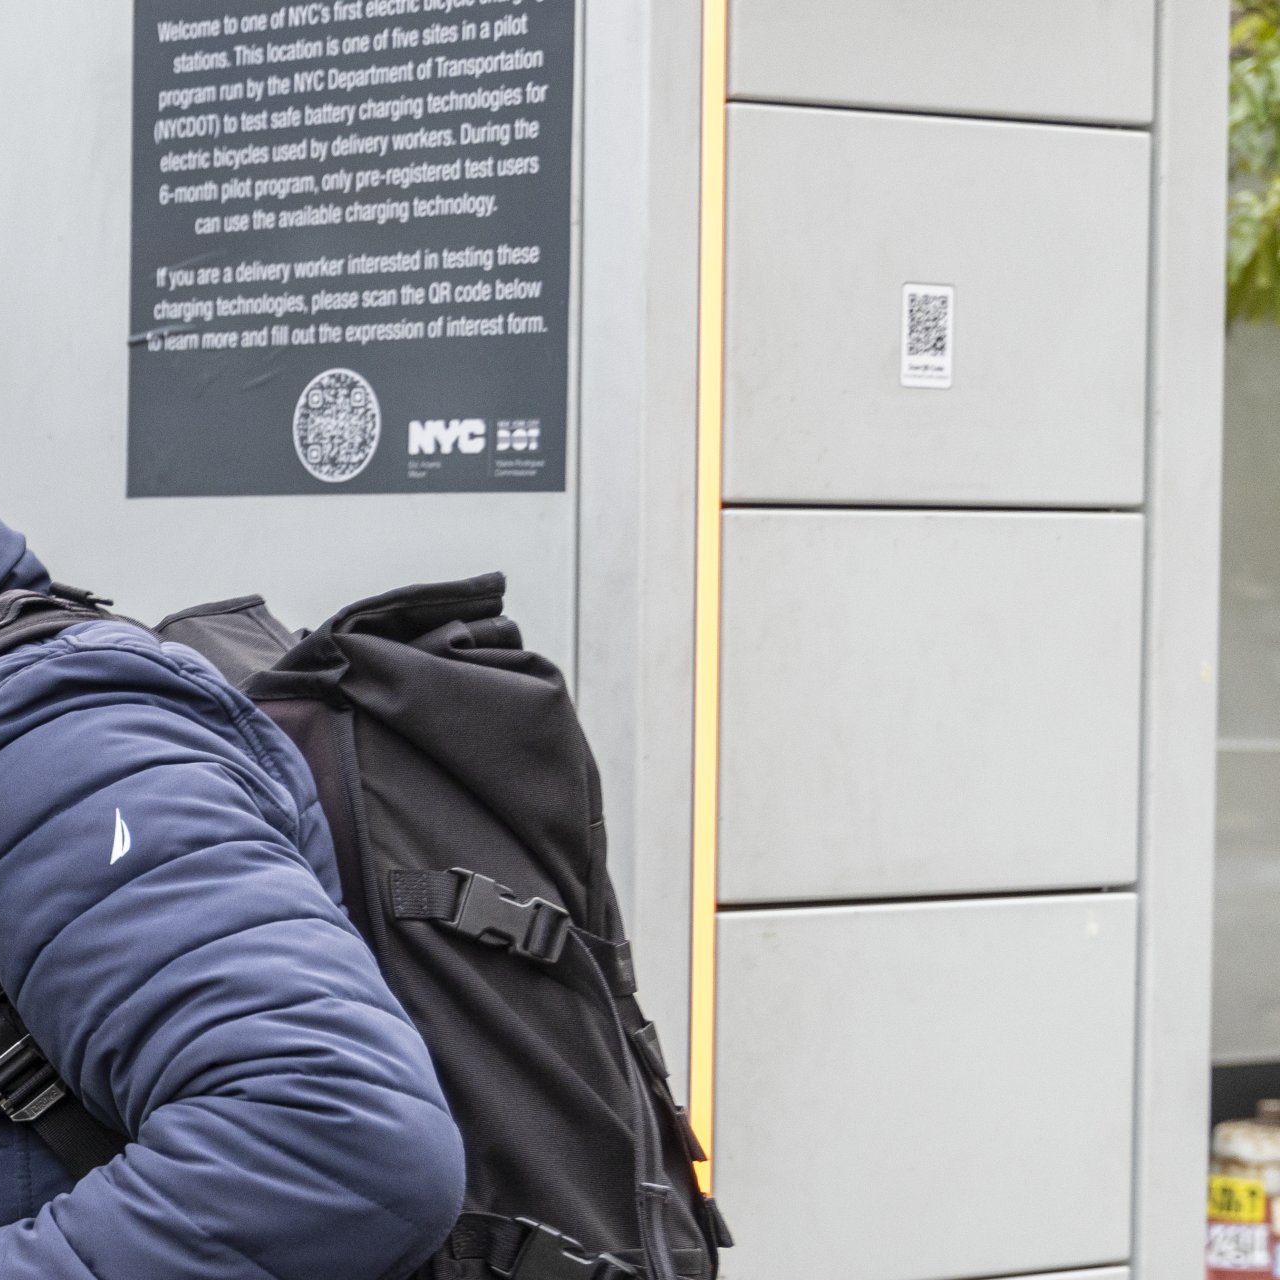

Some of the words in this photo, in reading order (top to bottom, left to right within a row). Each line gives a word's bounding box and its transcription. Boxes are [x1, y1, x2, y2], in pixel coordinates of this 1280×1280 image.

[157, 19, 220, 42] Welcome
[223, 15, 238, 35] to
[240, 13, 267, 33] one
[270, 7, 285, 29] of
[288, 2, 330, 27] NYC's
[333, 0, 363, 21] first
[365, 0, 420, 18] electric
[173, 50, 230, 73] stations.
[233, 44, 264, 66] This
[266, 38, 323, 62] location
[326, 35, 340, 56] is
[342, 34, 370, 54] one
[372, 28, 389, 51] of
[391, 27, 419, 48] five
[422, 23, 458, 45] sites
[461, 20, 476, 40] in
[479, 21, 490, 39] a
[493, 13, 528, 41] pilot
[158, 85, 216, 111] program
[219, 82, 243, 100] run
[246, 78, 264, 101] by
[267, 75, 290, 96] the
[293, 69, 324, 93] NYC
[327, 60, 414, 91] Department
[416, 57, 433, 80] of
[434, 47, 543, 78] Transportation
[154, 113, 220, 143] (NYCDOT)
[223, 114, 238, 133] to
[240, 110, 267, 132] test
[270, 106, 301, 129] safe
[304, 103, 356, 126] battery
[358, 95, 423, 121] charging
[426, 84, 522, 113] technologies
[525, 81, 548, 103] for
[160, 149, 210, 172] electric
[213, 143, 269, 170] bicycles
[272, 138, 307, 162] used
[310, 138, 328, 162] by
[331, 133, 389, 156] delivery
[391, 127, 456, 150] workers.
[460, 120, 510, 146] During
[513, 118, 539, 139] the
[159, 180, 218, 205] 6-month
[221, 177, 252, 203] pilot
[254, 175, 318, 200] program,
[321, 168, 353, 193] only
[355, 158, 461, 192] pre-registered
[464, 156, 494, 179] test
[497, 155, 539, 176] users
[194, 216, 220, 234] can
[223, 213, 249, 232] use
[252, 209, 276, 230] the
[278, 203, 342, 228] available
[345, 198, 409, 224] charging
[412, 192, 497, 217] technology.
[156, 266, 167, 286] If
[168, 269, 194, 290] you
[196, 267, 220, 285] are
[222, 266, 233, 283] a
[235, 261, 291, 283] delivery
[293, 256, 345, 278] worker
[347, 249, 421, 274] interested
[424, 248, 439, 269] in
[441, 246, 493, 271] testing
[496, 243, 540, 265] these
[153, 298, 213, 322] charging
[215, 292, 308, 317] technologies,
[311, 289, 359, 314] please
[361, 288, 397, 307] scan
[400, 284, 425, 305] the
[428, 281, 451, 304] QR
[454, 279, 492, 303] code
[495, 278, 542, 300] below
[146, 331, 161, 351] to
[163, 329, 199, 350] learn
[201, 331, 238, 348] more
[240, 326, 268, 347] and
[270, 325, 289, 345] fill
[291, 324, 315, 345] out
[318, 323, 342, 343] the
[345, 318, 424, 345] expression
[427, 316, 443, 338] of
[446, 314, 504, 337] interest
[506, 312, 547, 334] form.
[408, 419, 486, 455] NYC
